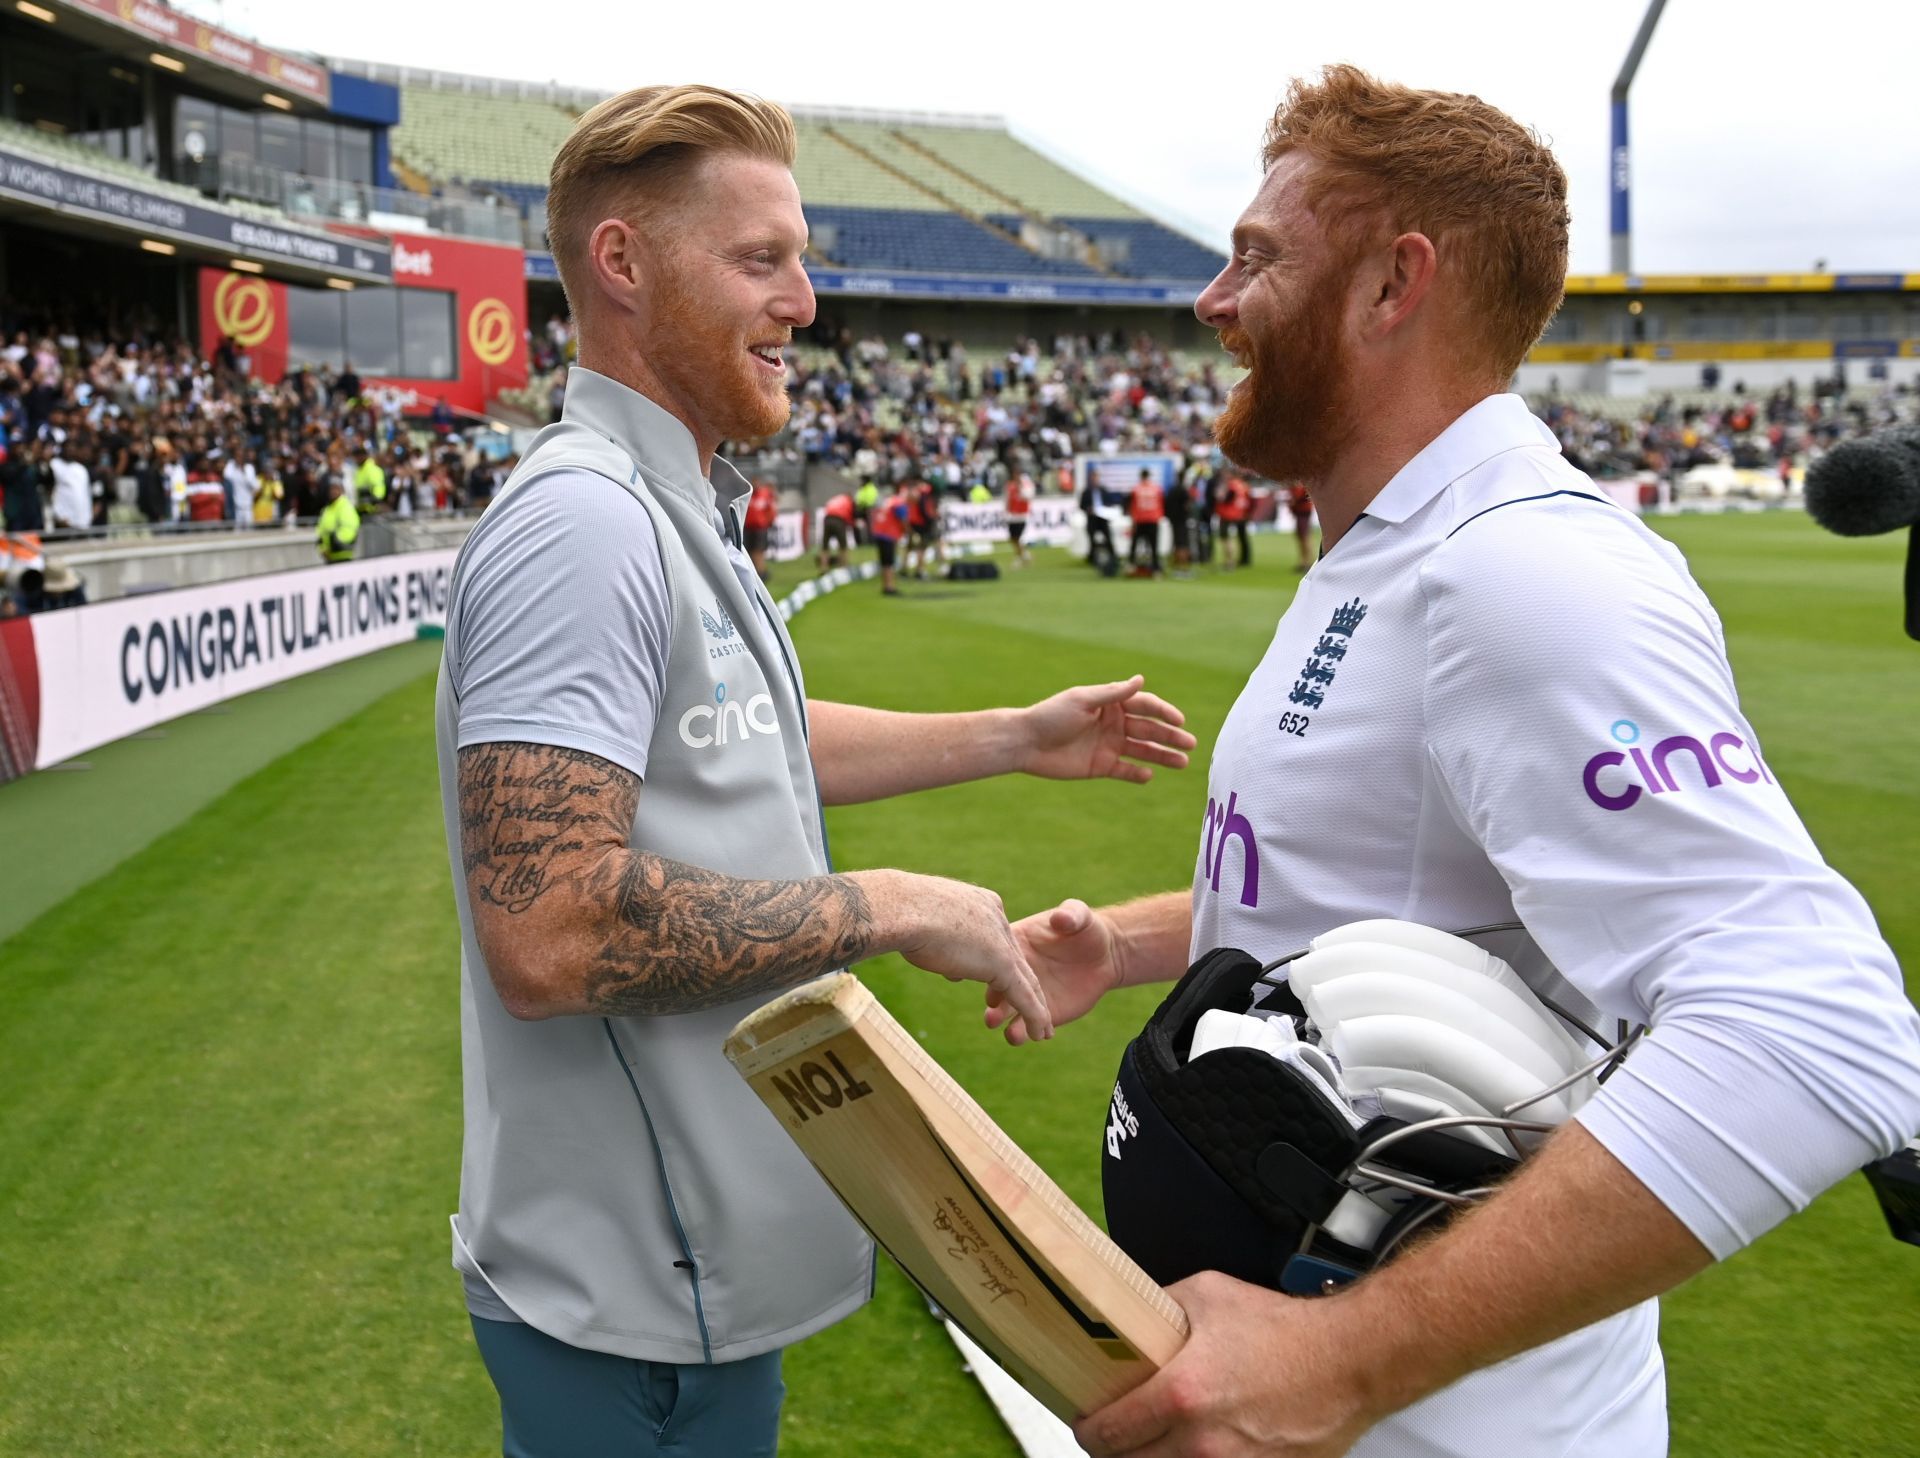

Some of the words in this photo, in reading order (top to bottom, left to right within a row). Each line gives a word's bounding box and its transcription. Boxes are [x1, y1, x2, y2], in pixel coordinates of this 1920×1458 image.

[119, 575, 400, 703] CONGRATULATIONS
[407, 566, 450, 620] ENG
[678, 682, 780, 749] cinc
[1278, 711, 1310, 738] 652
[1583, 719, 1773, 811] cinc
[769, 1050, 874, 1122] TON
[944, 1196, 989, 1248] BAIRSTOW
[987, 1250, 1019, 1280] JONNY
